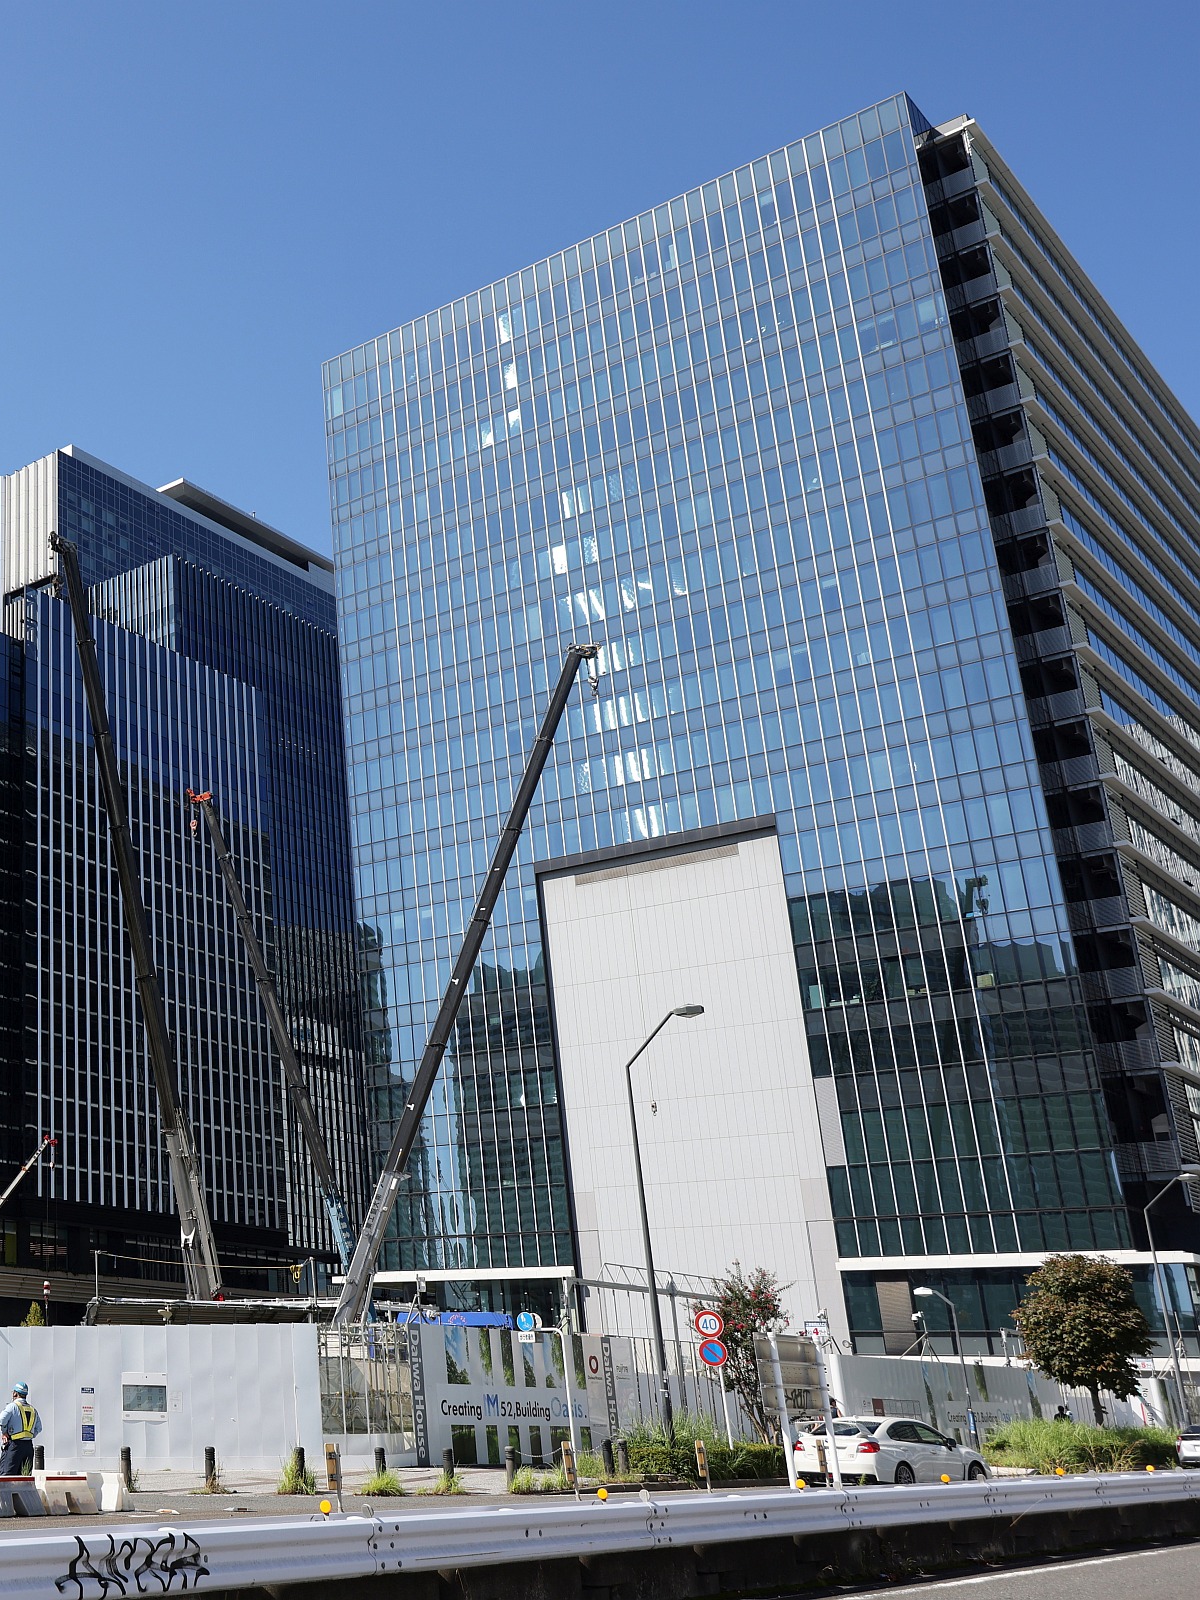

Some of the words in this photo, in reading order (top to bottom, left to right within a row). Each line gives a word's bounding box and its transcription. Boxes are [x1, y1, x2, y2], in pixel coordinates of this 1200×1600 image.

[702, 1318, 717, 1330] 40
[410, 1329, 422, 1391] Daiwa
[602, 1342, 613, 1397] Daiwa
[414, 1395, 426, 1459] House
[440, 1399, 482, 1420] Creating
